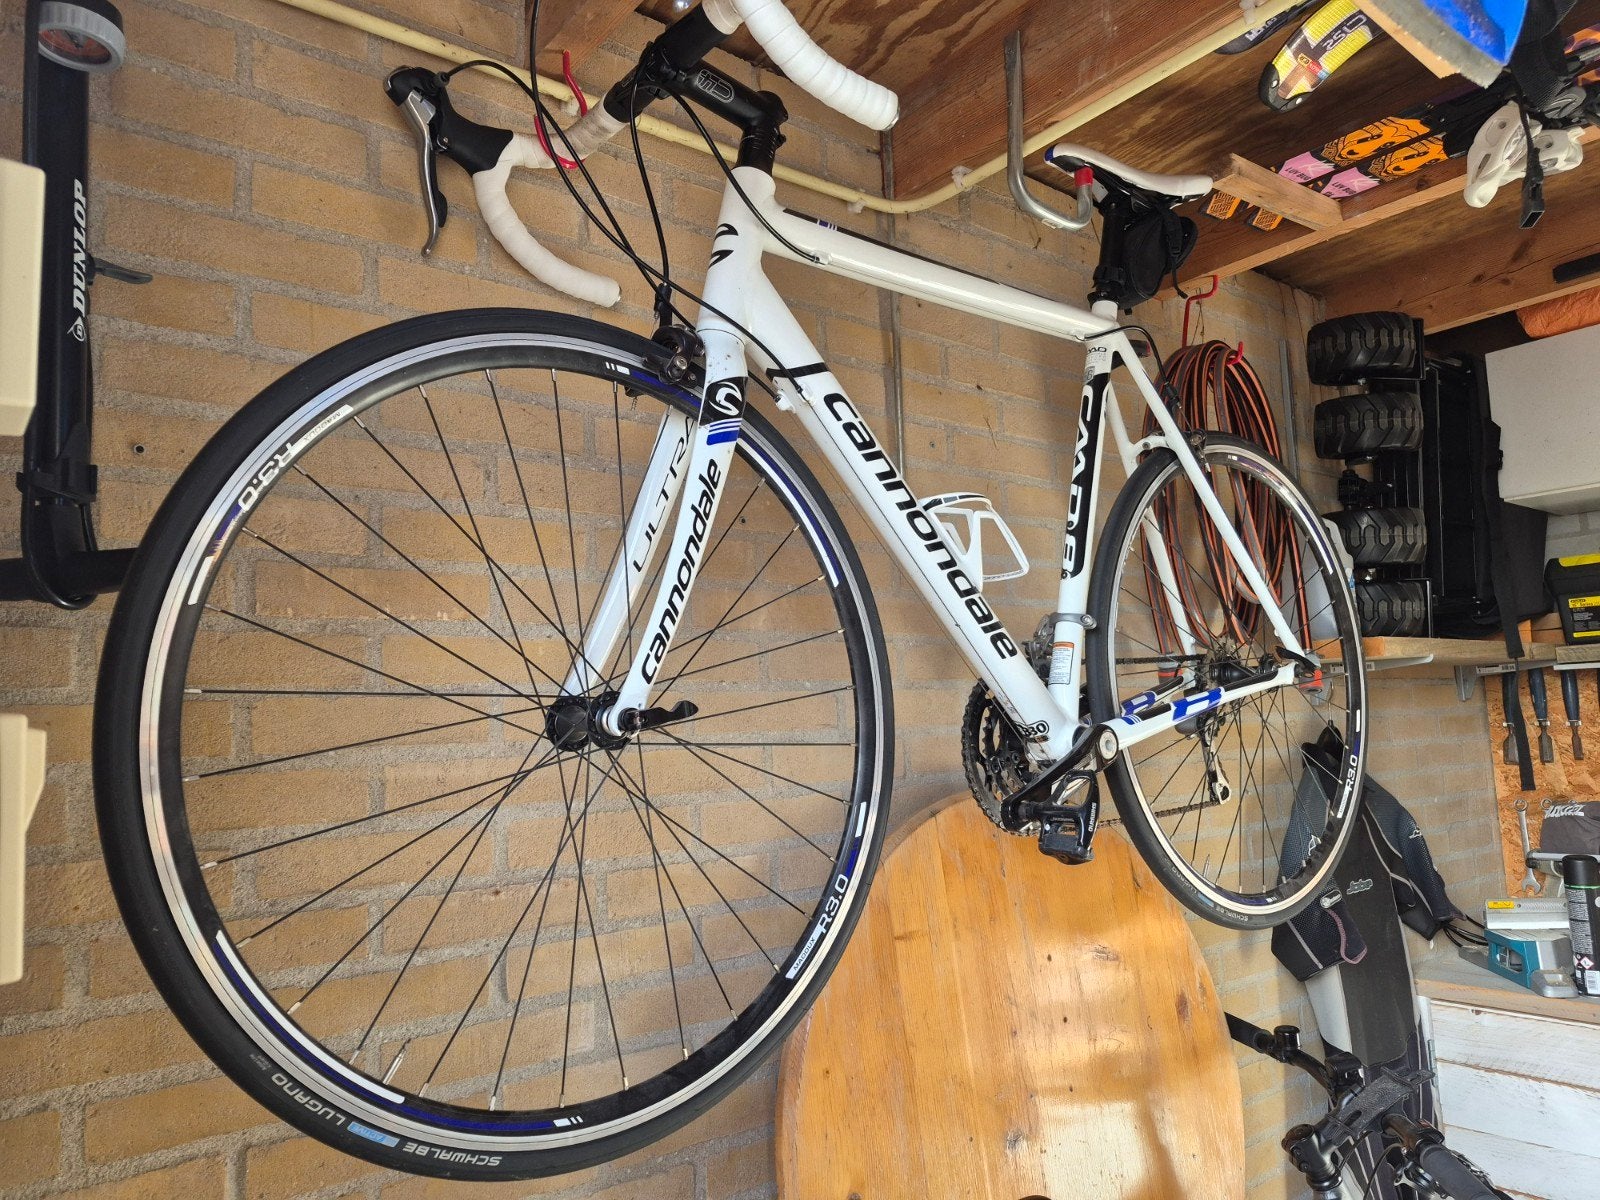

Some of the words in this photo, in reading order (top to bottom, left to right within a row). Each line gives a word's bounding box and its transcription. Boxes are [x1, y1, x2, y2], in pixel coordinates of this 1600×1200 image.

[73, 178, 87, 317] DUNLOP
[238, 442, 293, 511] R3.0
[823, 392, 1018, 660] cannondale
[641, 458, 721, 685] cannondale
[1345, 754, 1358, 791] R3.0
[792, 937, 816, 971] MADDUX
[819, 873, 849, 934] R3.0
[271, 1073, 347, 1126] LUGANO
[402, 1140, 503, 1167] SCHWALBE
